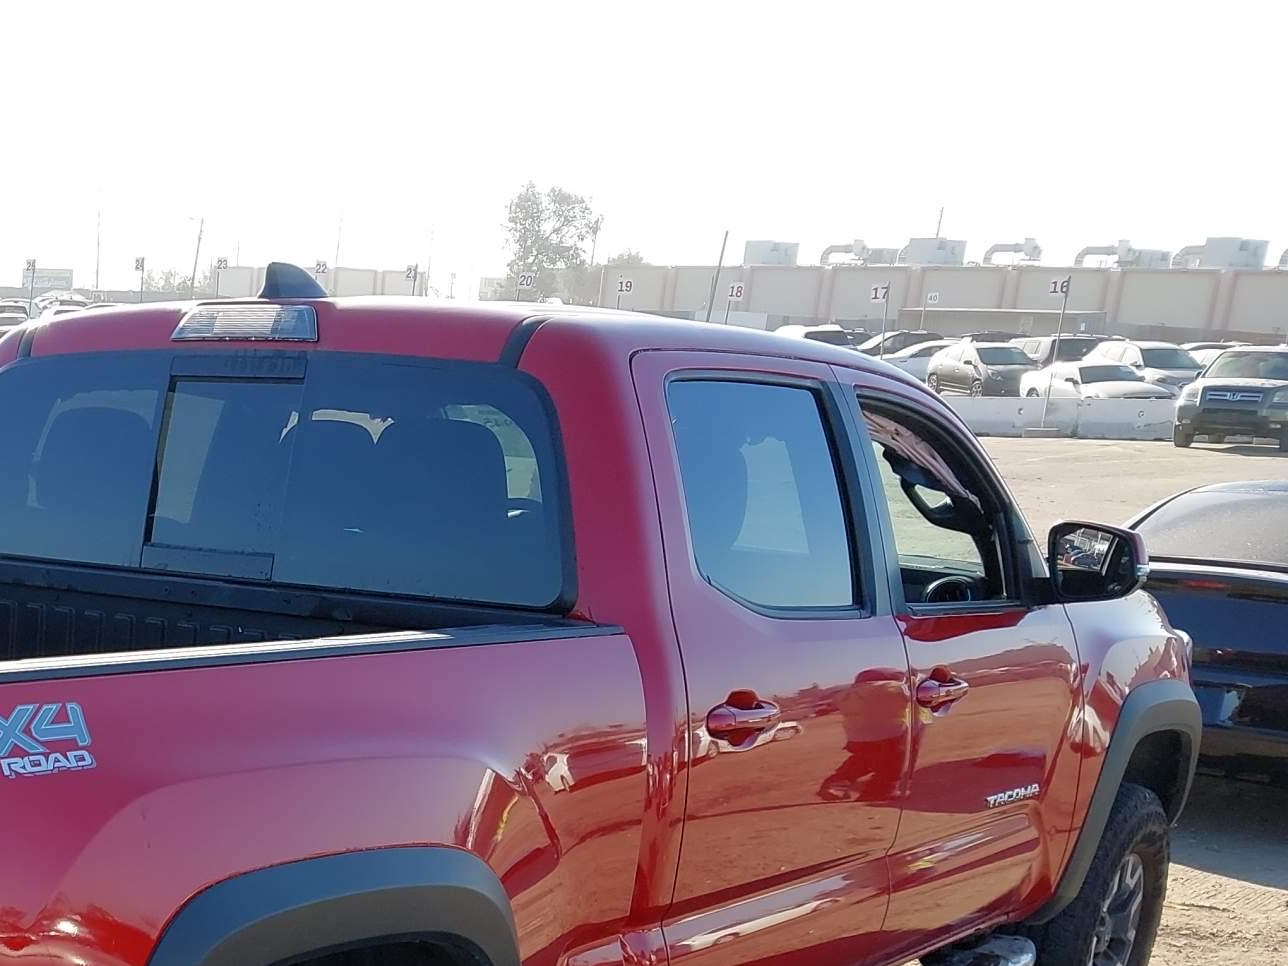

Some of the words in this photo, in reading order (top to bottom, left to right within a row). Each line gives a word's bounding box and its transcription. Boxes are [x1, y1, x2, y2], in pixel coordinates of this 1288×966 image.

[216, 259, 228, 270] 23
[315, 263, 328, 274] 22
[518, 274, 533, 287] 20
[617, 280, 633, 293] 19
[1049, 279, 1070, 294] 16
[728, 285, 743, 298] 18
[871, 286, 889, 300] 17
[1, 749, 97, 780] ROAD
[985, 783, 1041, 808] TACOMA
